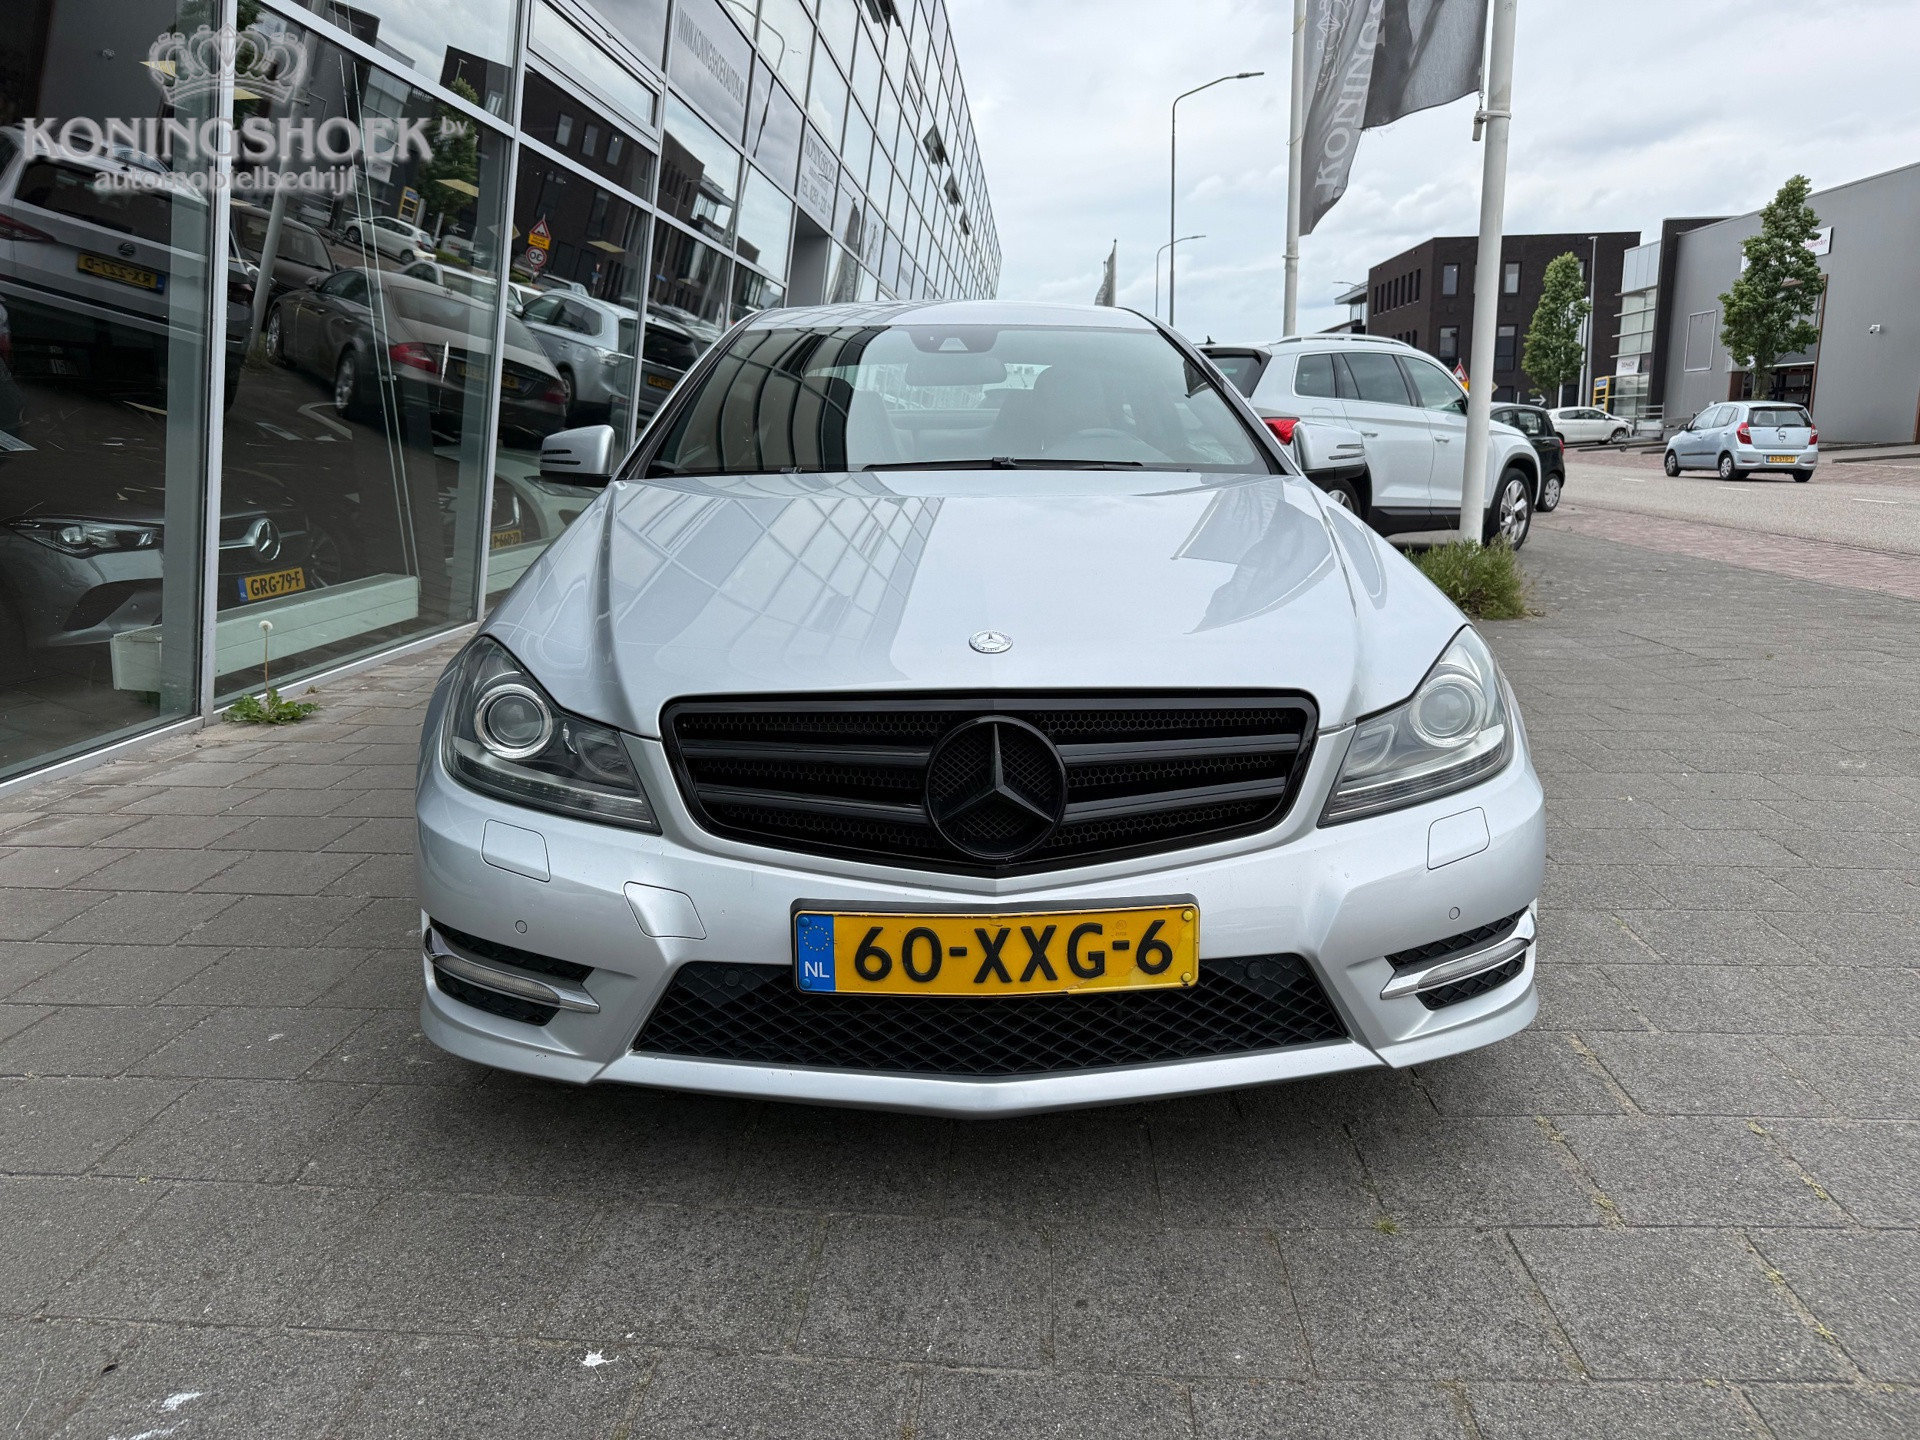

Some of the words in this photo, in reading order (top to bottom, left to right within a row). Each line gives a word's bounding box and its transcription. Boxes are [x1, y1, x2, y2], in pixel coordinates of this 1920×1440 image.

[250, 571, 301, 596] GRG-79-F
[853, 919, 1174, 983] 60-XXG-6
[804, 961, 830, 978] NL
